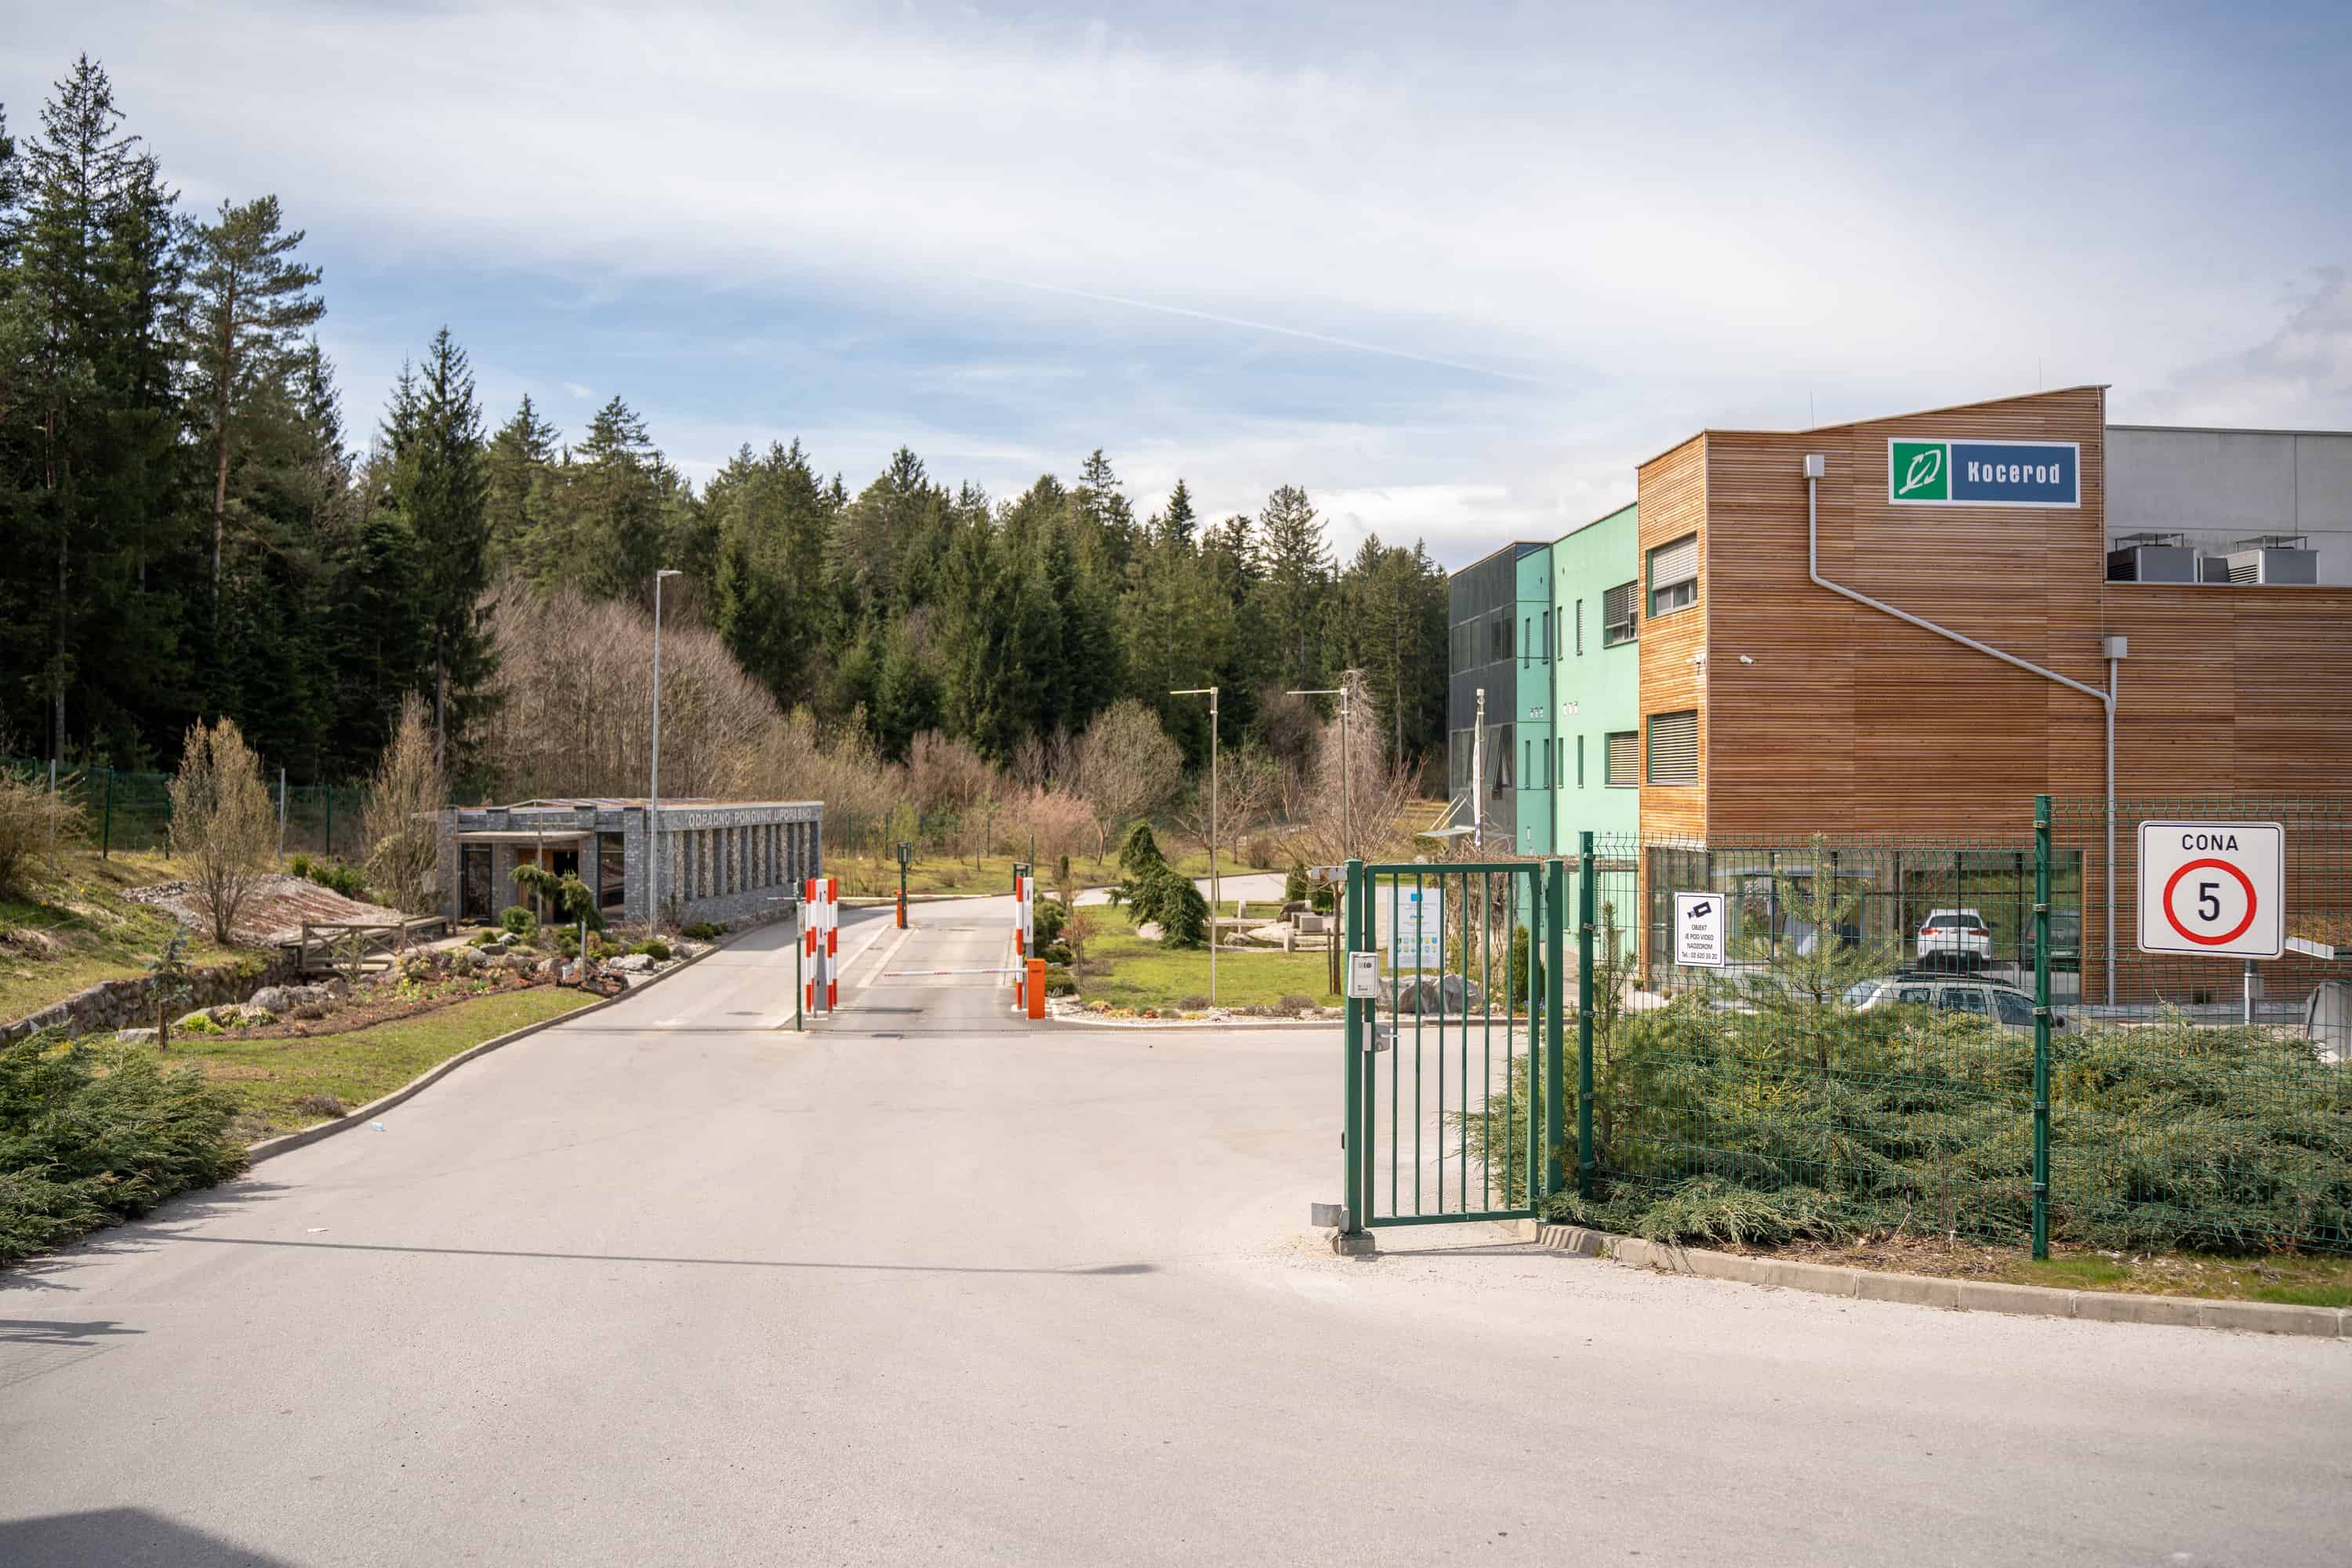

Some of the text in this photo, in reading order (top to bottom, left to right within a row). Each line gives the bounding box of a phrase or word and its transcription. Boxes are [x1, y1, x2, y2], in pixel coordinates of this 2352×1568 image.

[1968, 461, 2060, 483] Kocerod
[688, 811, 730, 828] ODPADNO
[734, 809, 771, 824] PONOVNO
[2182, 834, 2238, 851] CONA
[2198, 882, 2220, 921] 5
